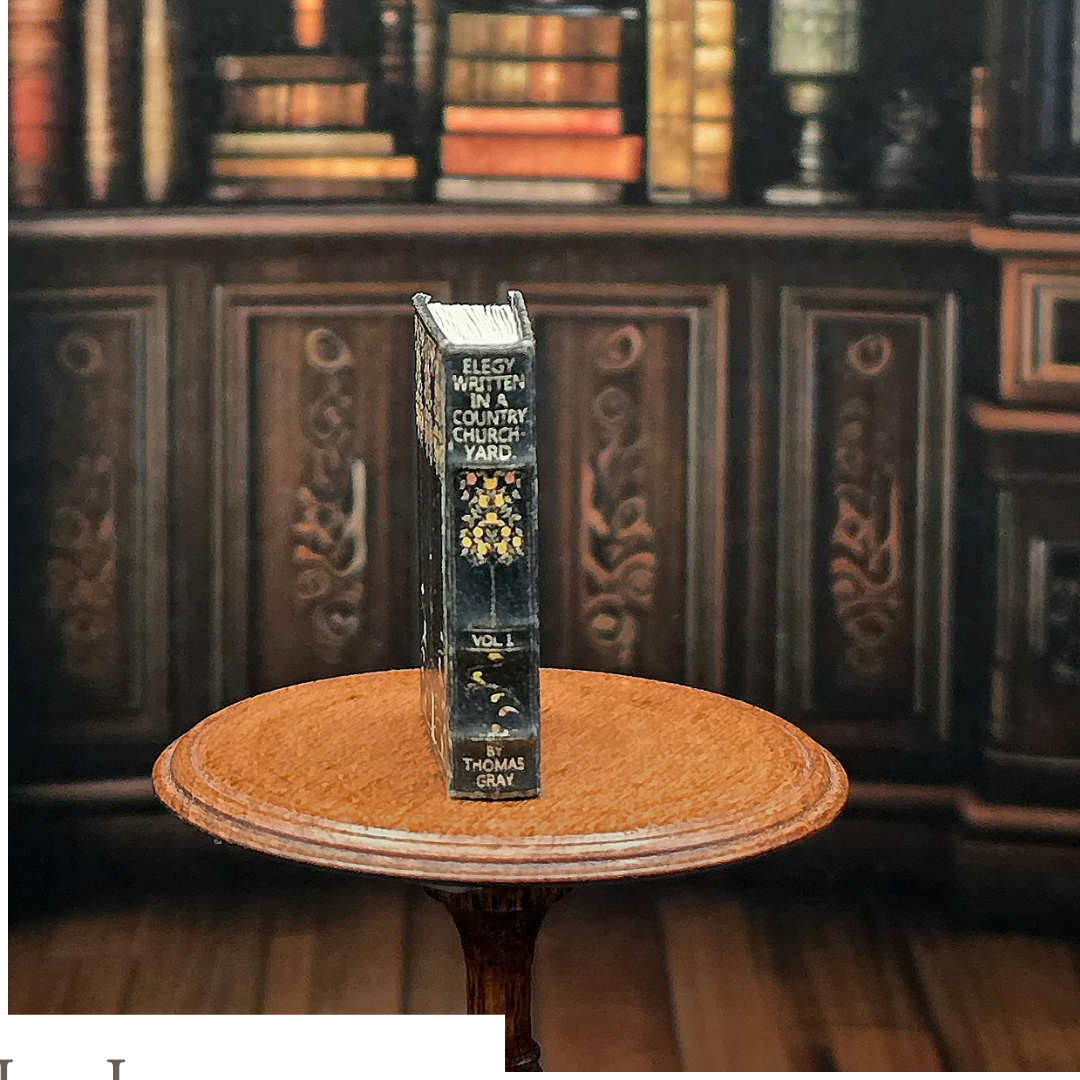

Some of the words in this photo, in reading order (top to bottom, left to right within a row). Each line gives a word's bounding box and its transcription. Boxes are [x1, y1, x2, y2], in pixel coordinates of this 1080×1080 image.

[462, 357, 516, 375] ELEGY
[451, 374, 525, 392] WRITTEN
[470, 392, 491, 409] IN
[494, 392, 508, 408] A
[452, 407, 528, 426] COUNTRY
[464, 444, 517, 461] YARD.
[486, 744, 503, 757] BY
[462, 756, 525, 772] THOMAS
[476, 773, 514, 788] GRAY
